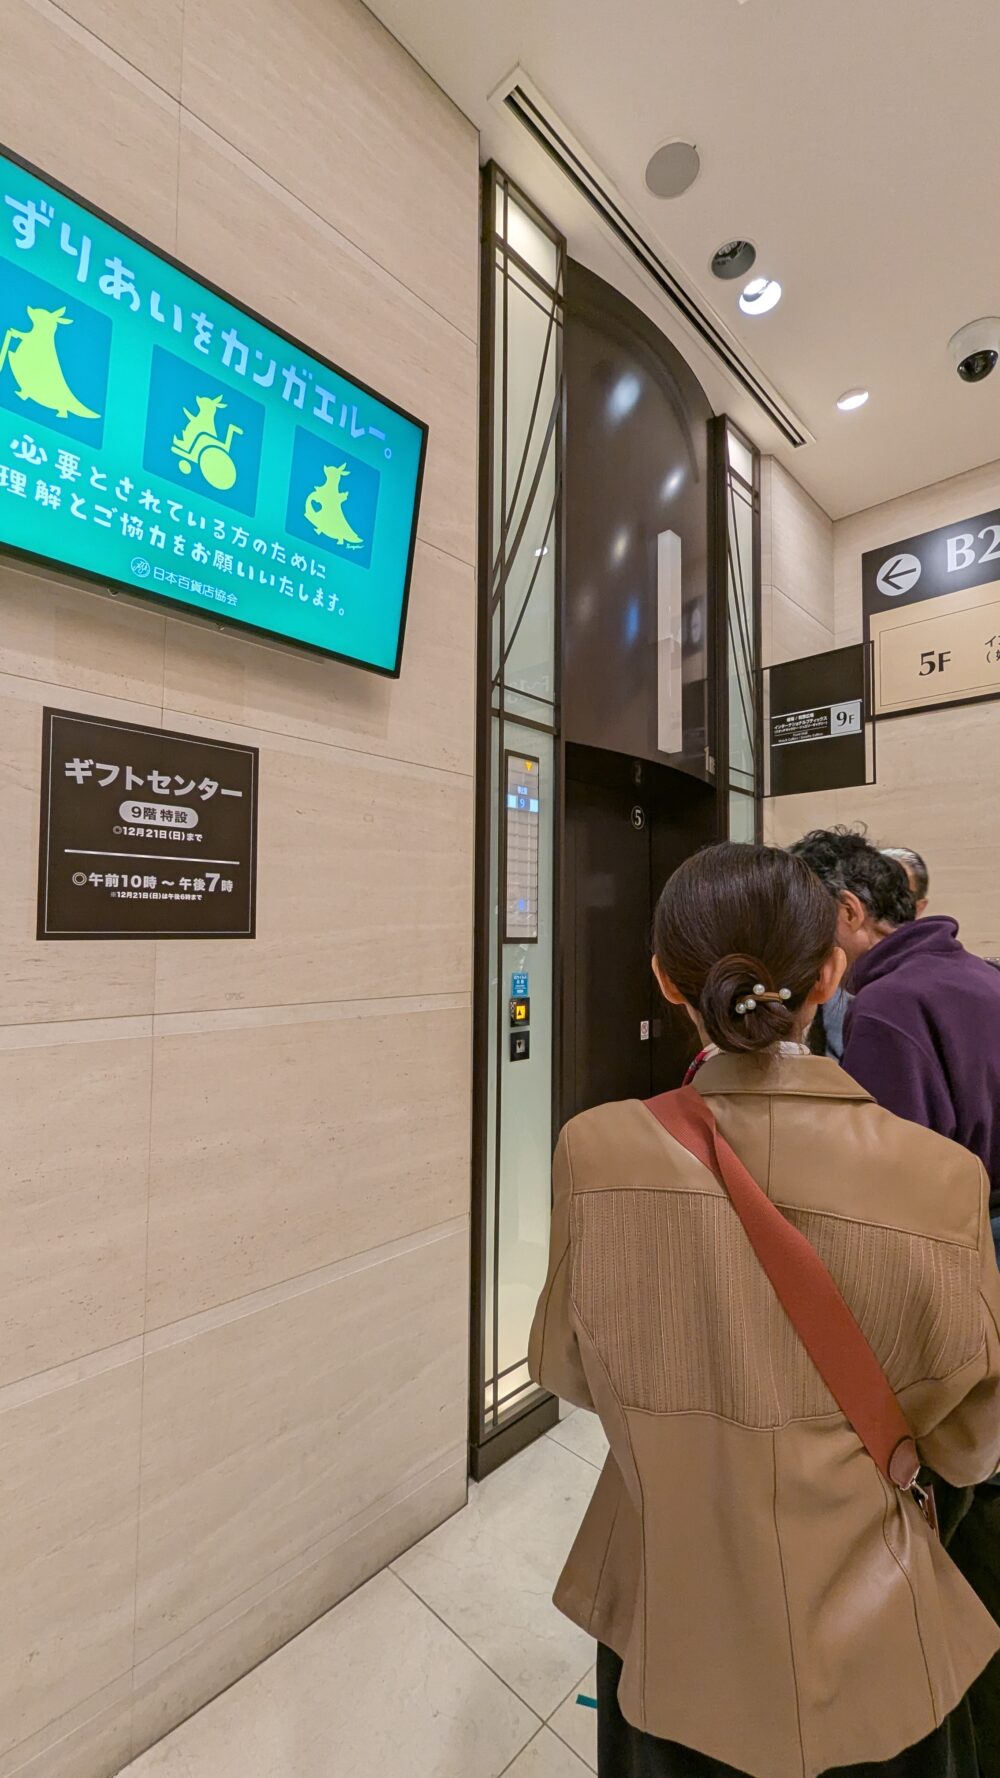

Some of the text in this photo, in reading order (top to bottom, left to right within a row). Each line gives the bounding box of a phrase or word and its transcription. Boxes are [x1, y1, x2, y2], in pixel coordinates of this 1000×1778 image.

[4, 194, 392, 460] ずりあいをカンガエルー。
[9, 434, 326, 580] 必要とされている方のために
[0, 464, 345, 616] 理解とご協力をお願いいたします。
[946, 524, 1000, 573] B2
[153, 566, 238, 607] 日本百貨店協会
[918, 650, 952, 676] 5F
[836, 711, 855, 727] 9F
[64, 758, 243, 802] ギフトセンター
